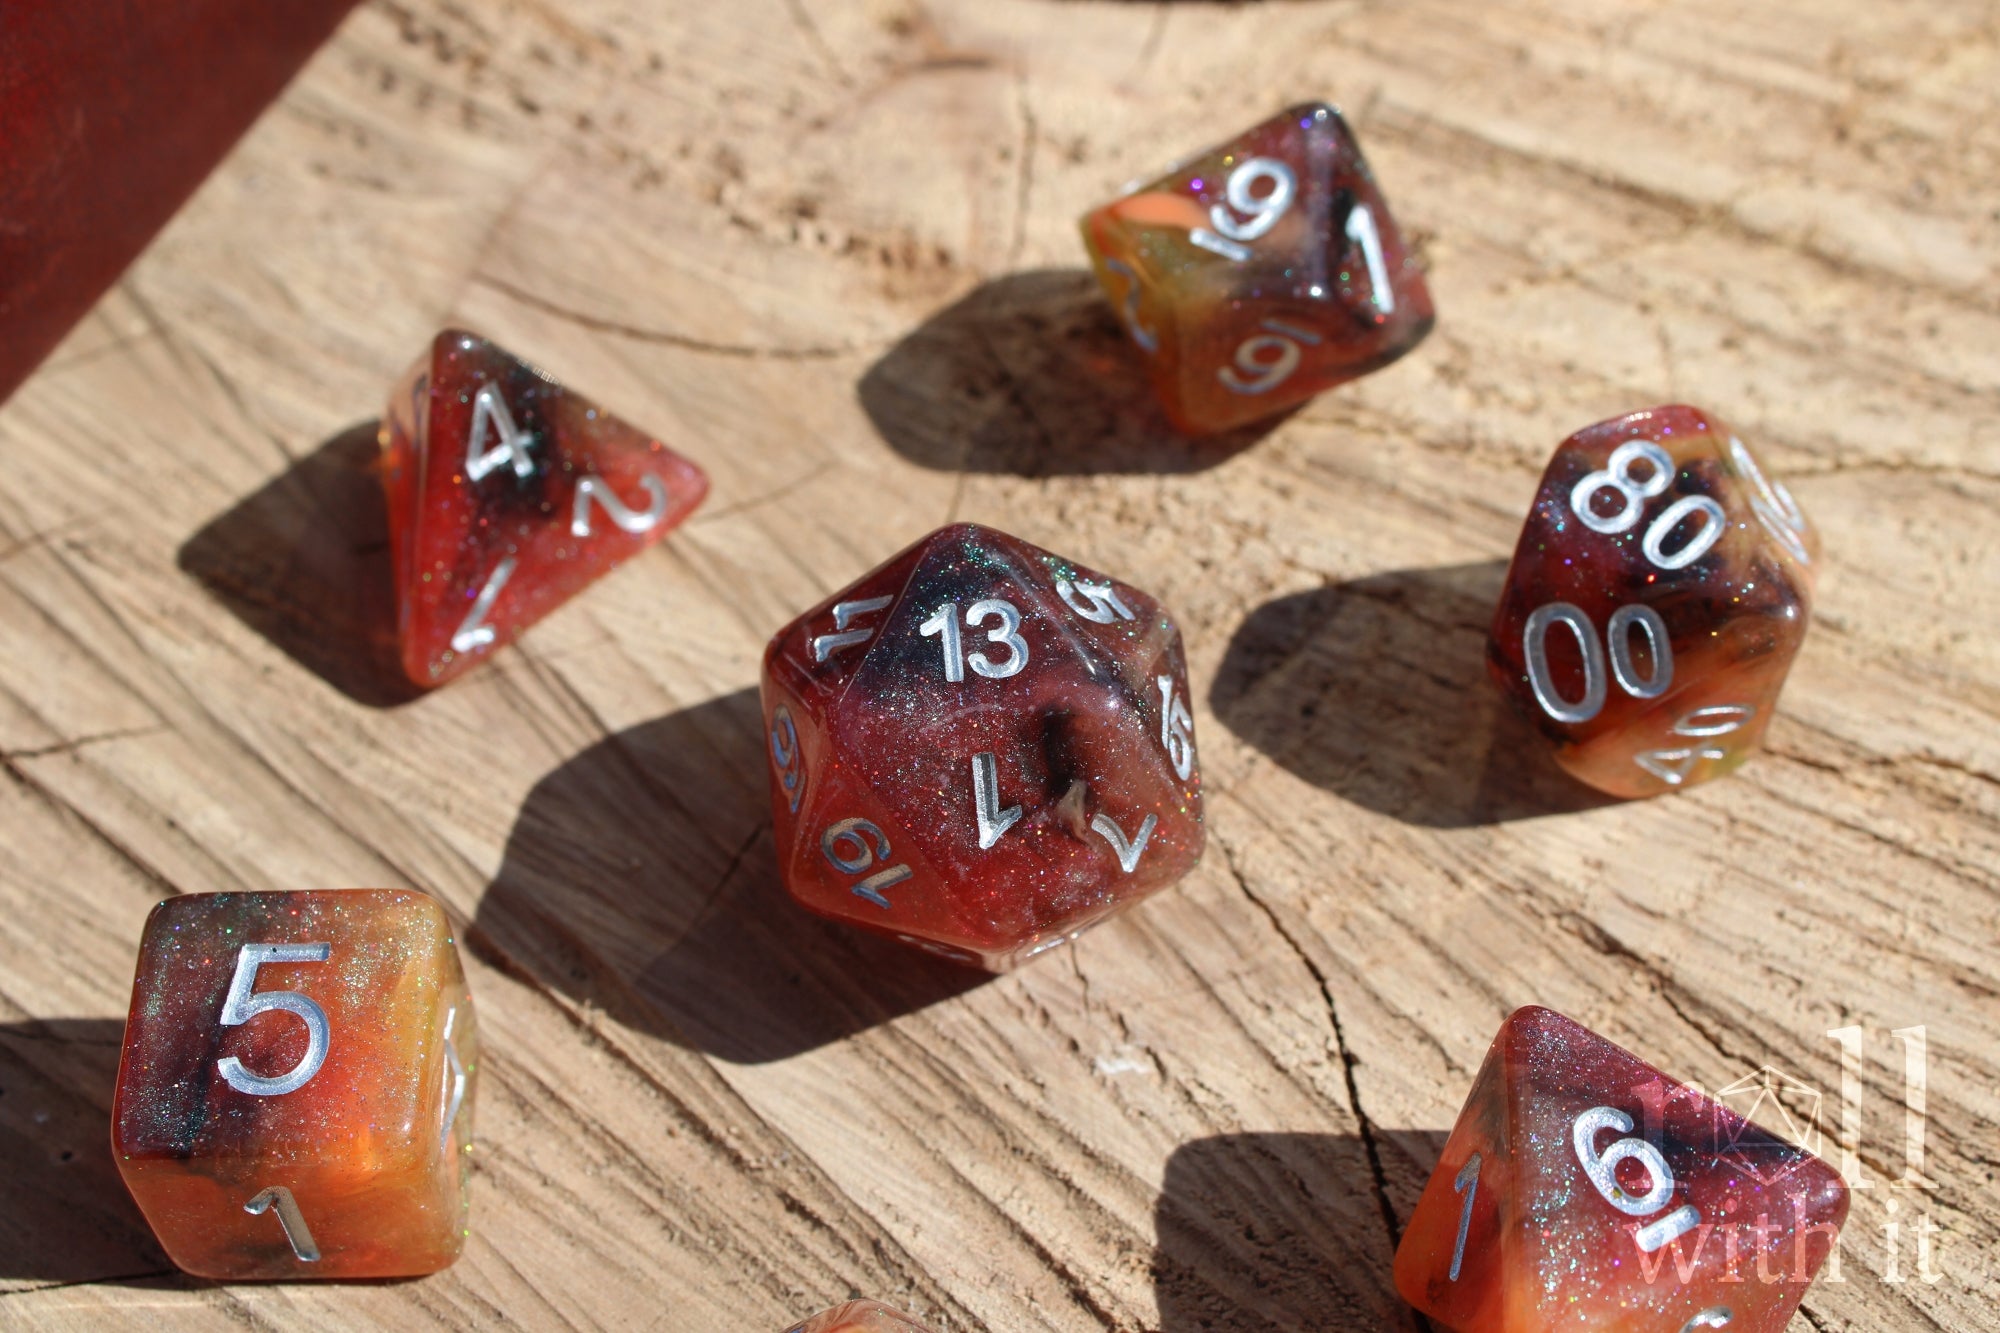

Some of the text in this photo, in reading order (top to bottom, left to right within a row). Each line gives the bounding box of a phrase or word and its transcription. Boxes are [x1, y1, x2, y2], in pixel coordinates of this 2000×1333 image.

[1346, 203, 1396, 315] 1
[465, 379, 536, 483] 4
[570, 474, 669, 538] 2
[1569, 438, 1727, 571] 80
[450, 556, 519, 654] 1
[814, 594, 895, 663] 11
[919, 598, 1030, 683] 13
[1522, 602, 1675, 724] 00
[971, 751, 1023, 850] 1
[217, 942, 331, 1096] 5
[243, 1185, 321, 1262] 1
[1449, 1152, 1483, 1283] 1
